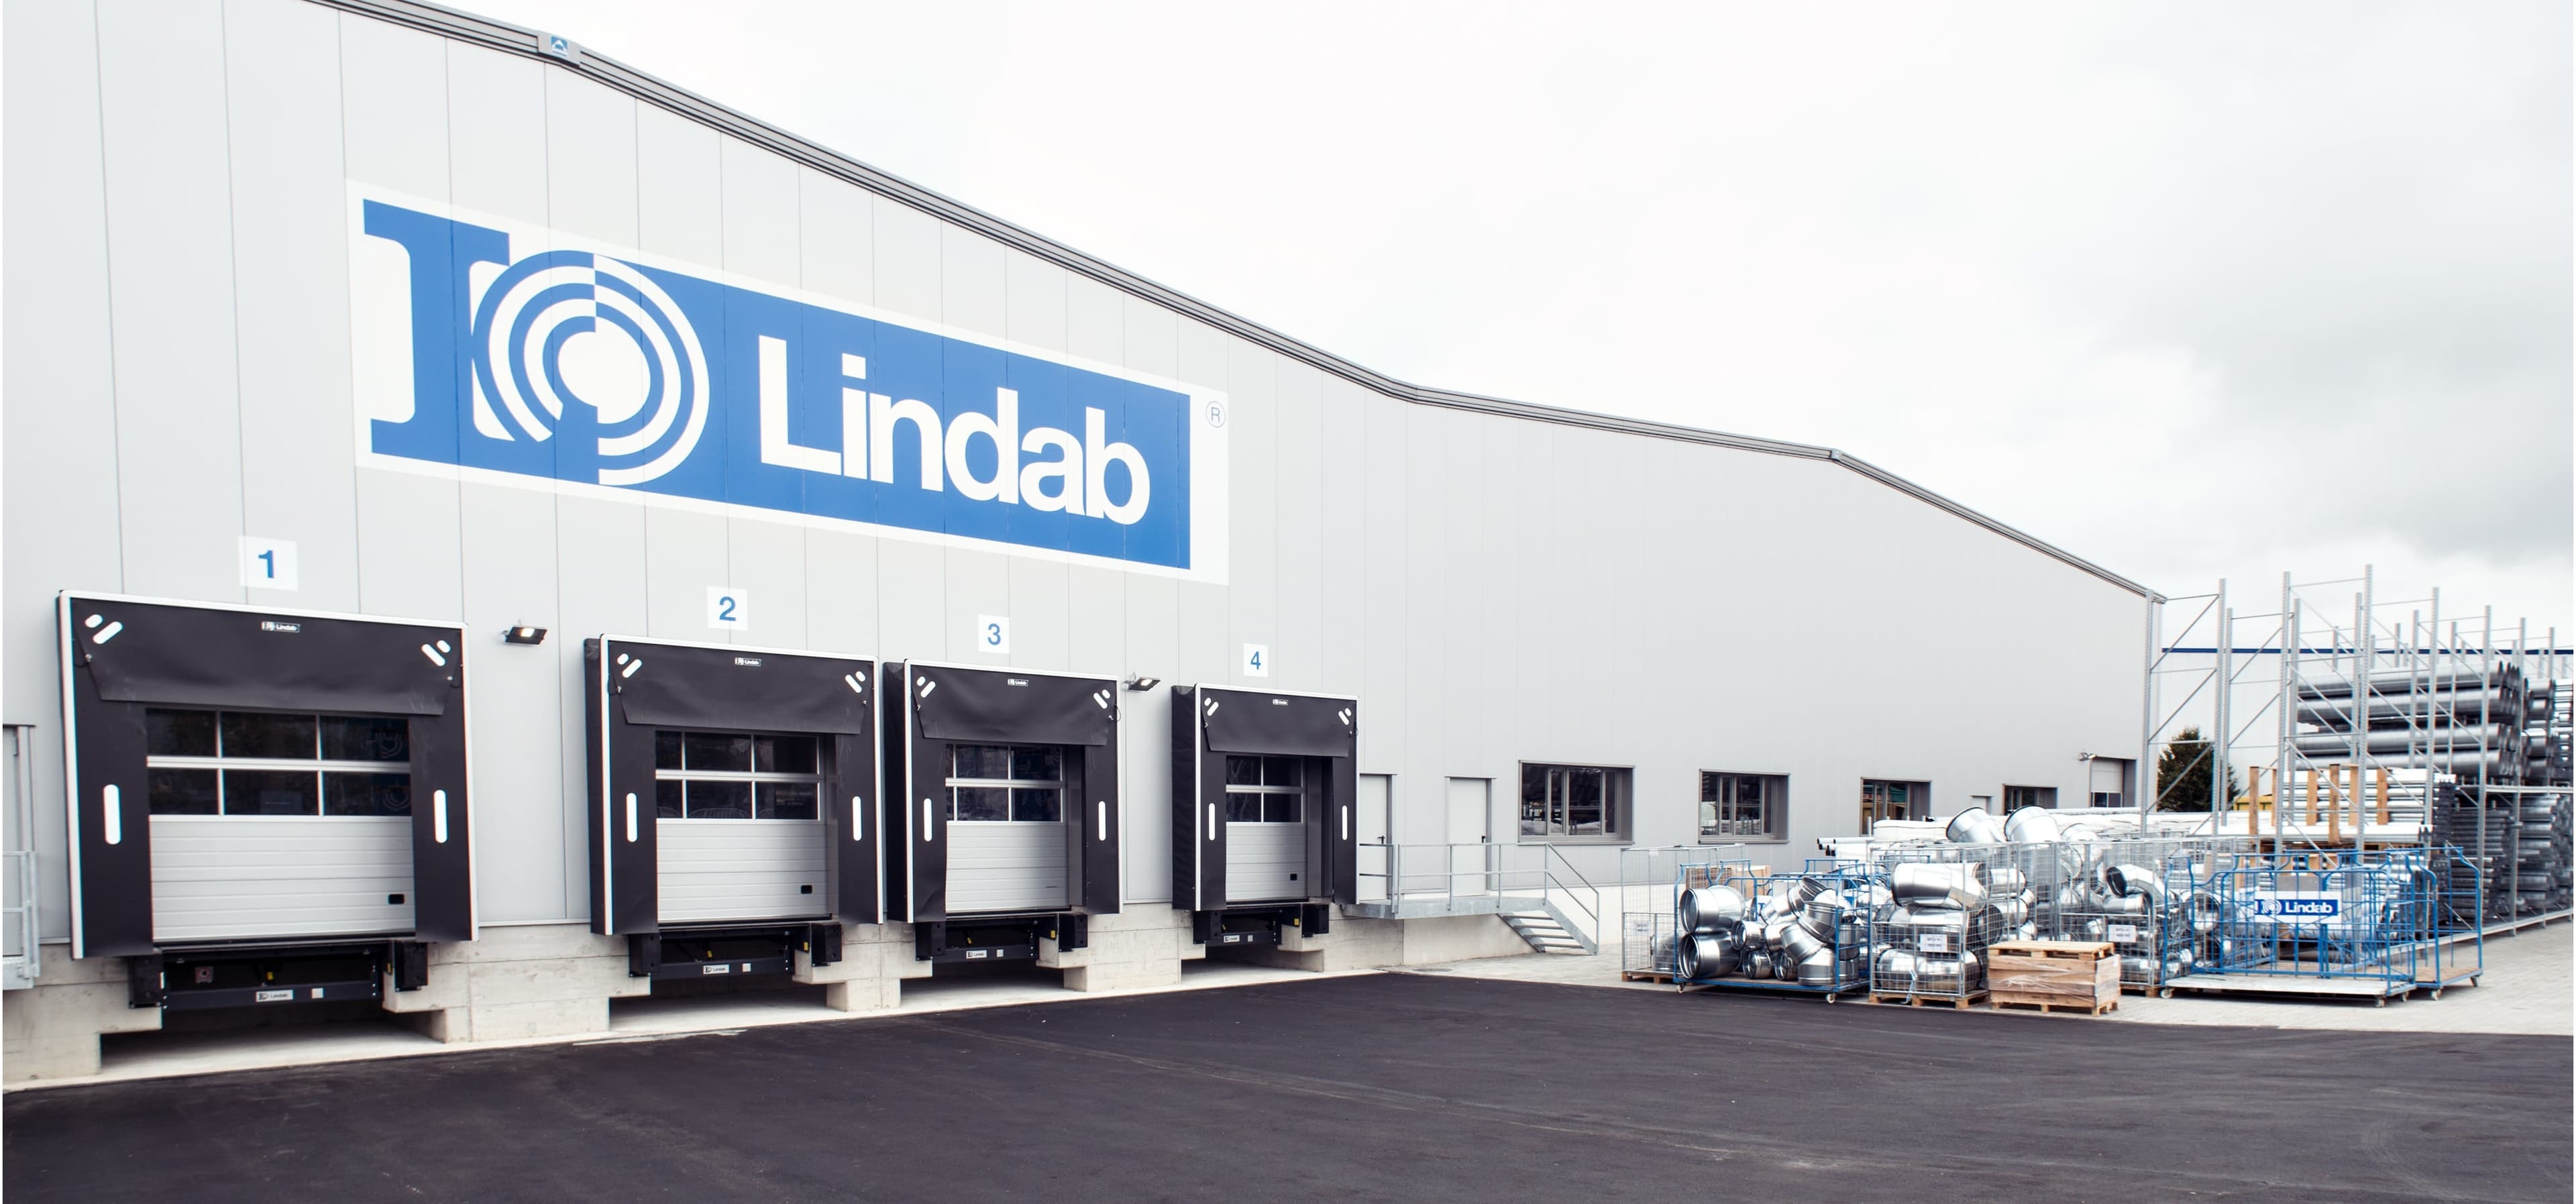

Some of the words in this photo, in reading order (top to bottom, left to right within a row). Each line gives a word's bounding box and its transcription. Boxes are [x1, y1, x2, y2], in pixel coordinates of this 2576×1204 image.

[759, 335, 1150, 525] Lindab
[258, 549, 275, 579] 1
[718, 596, 737, 622] 2
[987, 623, 1002, 645] 3
[1250, 651, 1262, 670] 4
